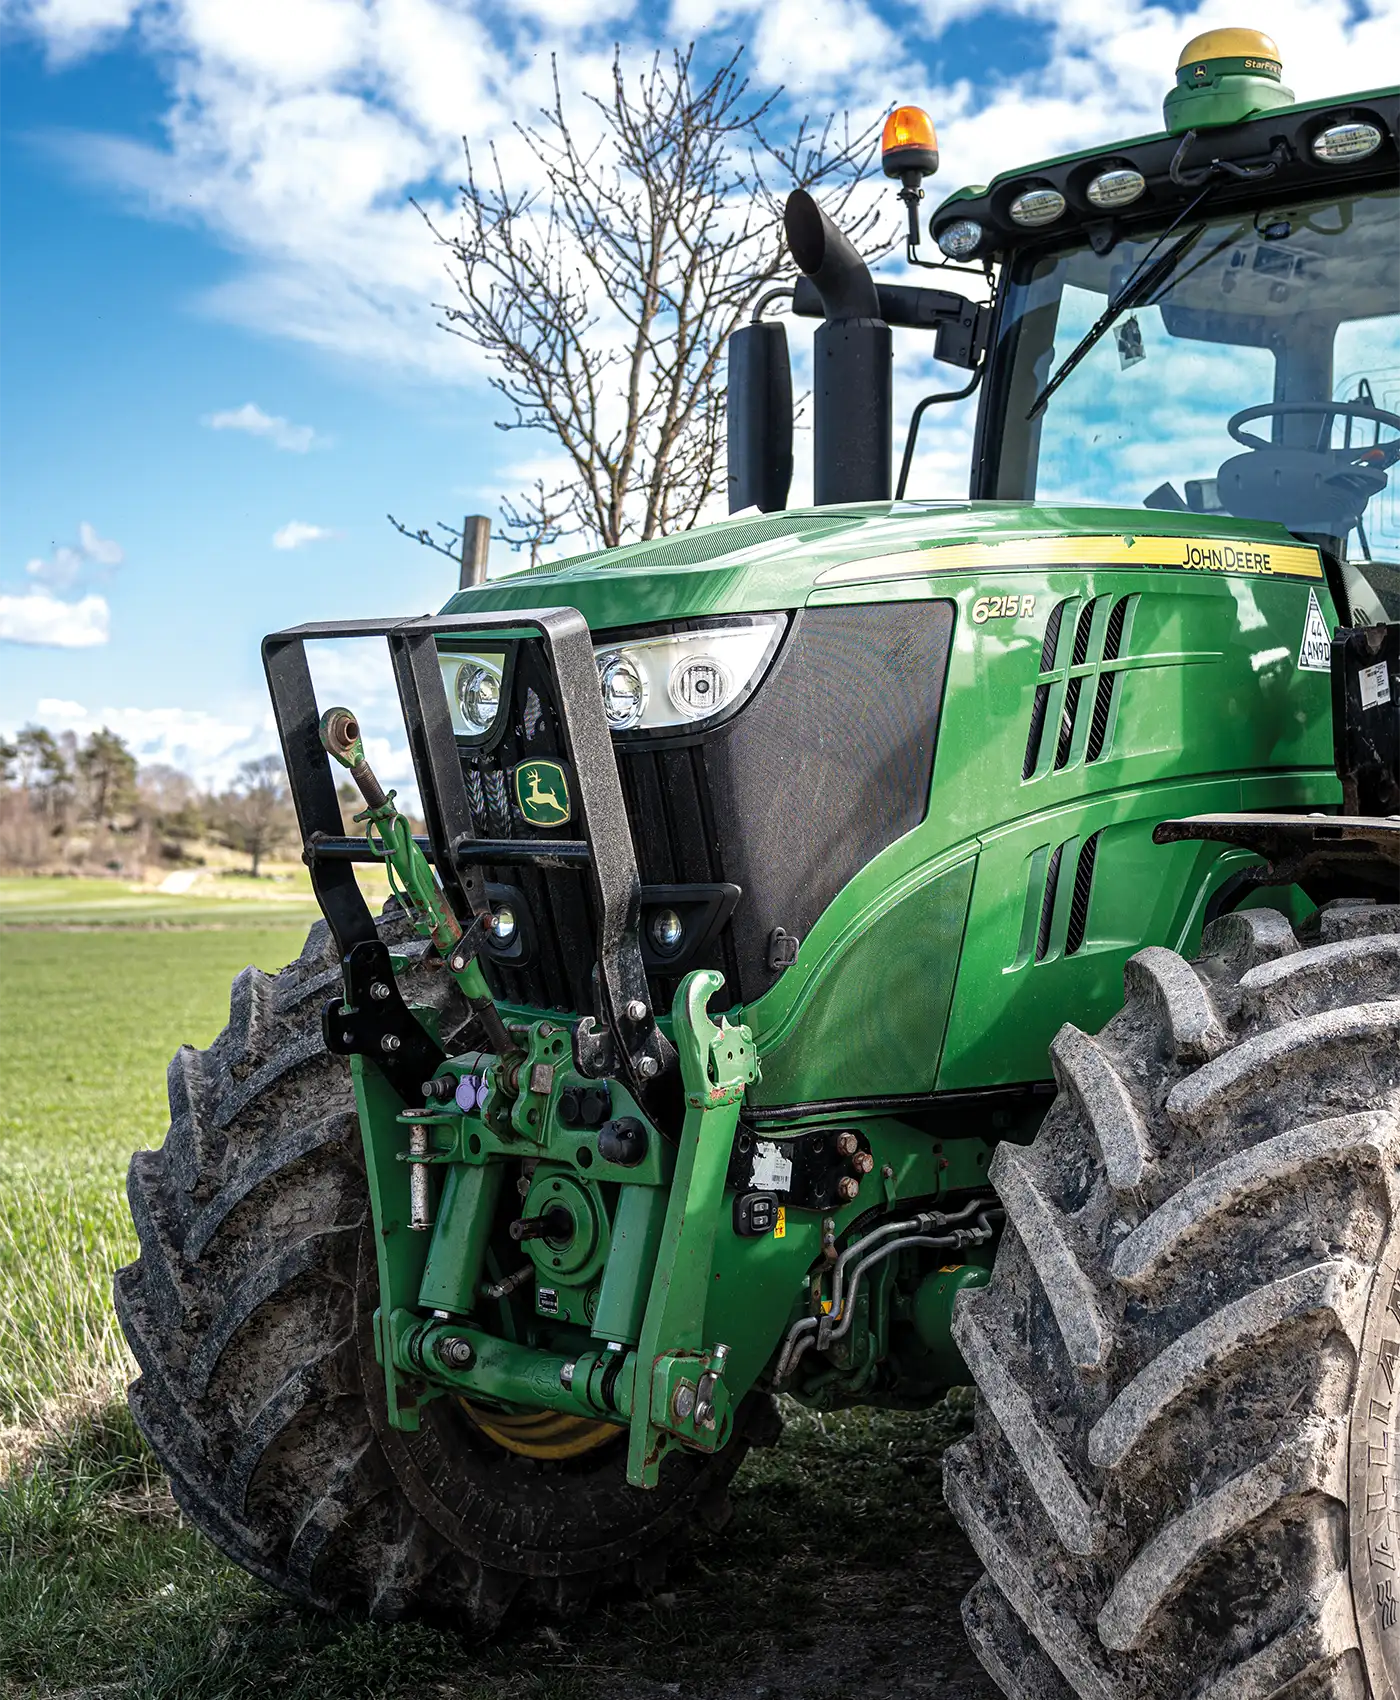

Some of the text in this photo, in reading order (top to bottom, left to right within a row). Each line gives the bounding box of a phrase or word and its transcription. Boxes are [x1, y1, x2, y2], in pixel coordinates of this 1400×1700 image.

[1182, 543, 1272, 571] JOHN DEERE
[972, 594, 1036, 625] 6215R
[1311, 620, 1322, 637] 44
